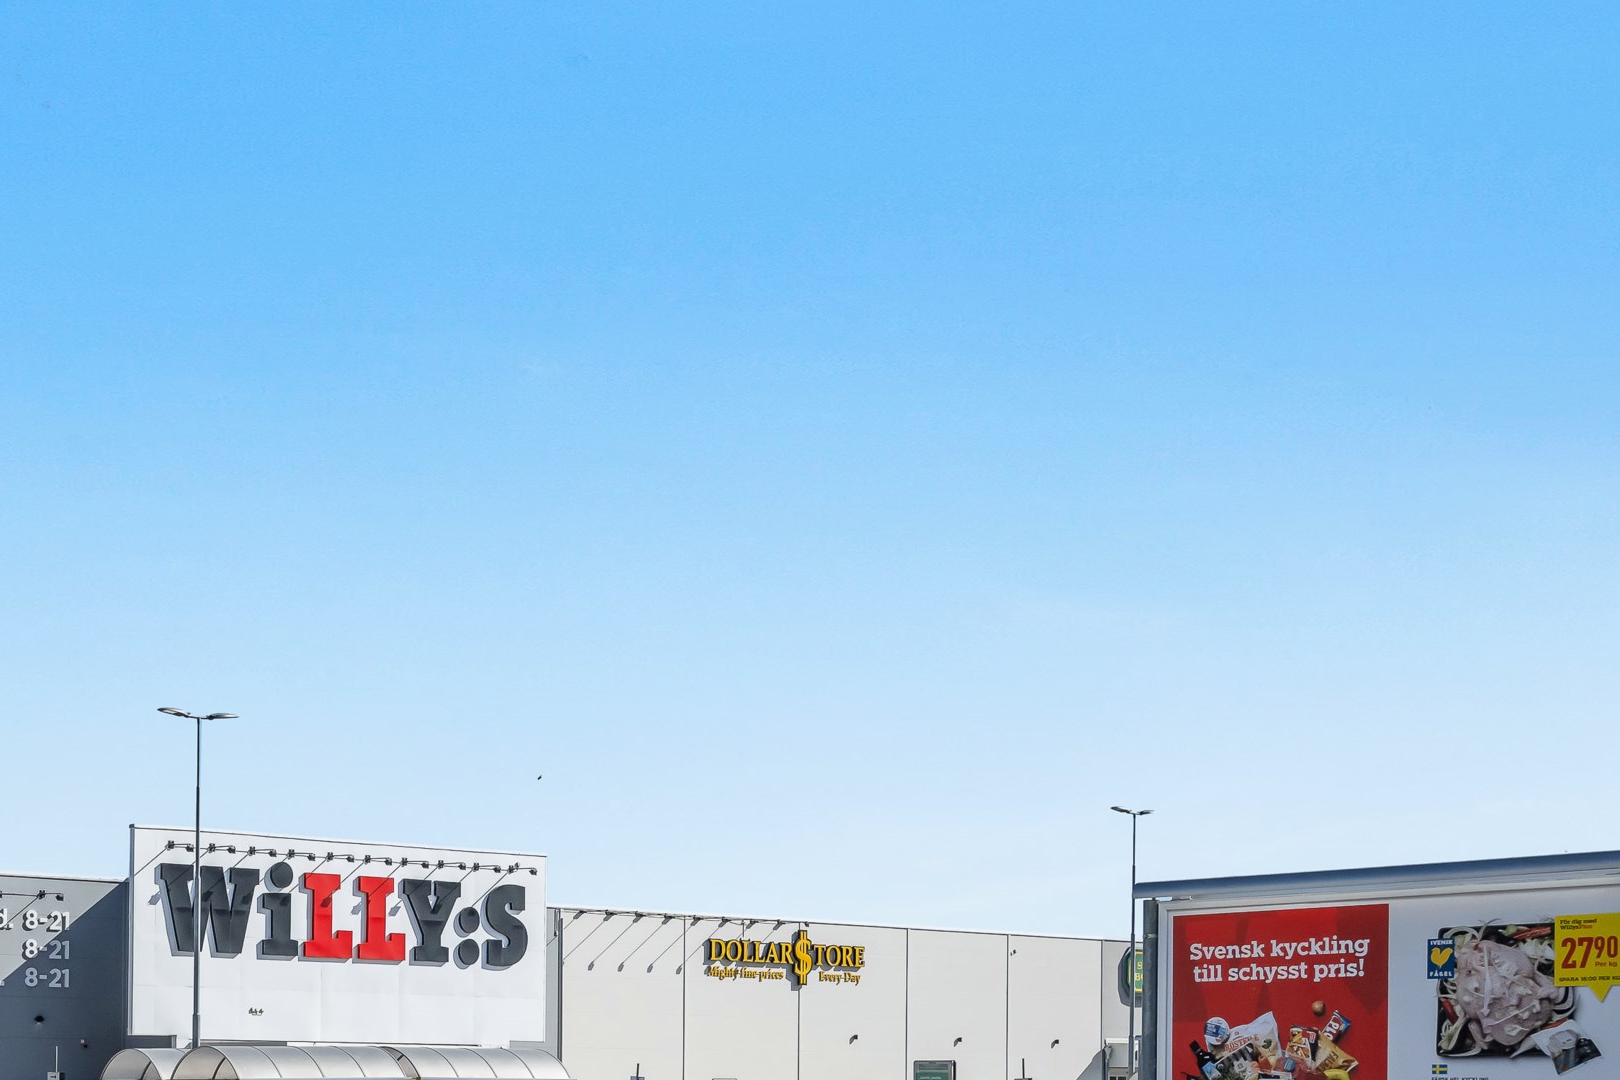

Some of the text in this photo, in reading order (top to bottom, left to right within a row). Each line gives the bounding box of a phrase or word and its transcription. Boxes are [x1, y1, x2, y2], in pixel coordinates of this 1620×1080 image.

[24, 909, 70, 930] 8-21
[24, 938, 70, 960] 8-21
[1190, 935, 1370, 960] Svensk kyckling
[1193, 958, 1365, 983] till schysst pris!
[1609, 960, 1618, 968] kg
[24, 967, 70, 988] 8-21
[759, 968, 784, 982] prices
[818, 971, 861, 986] Every Day
